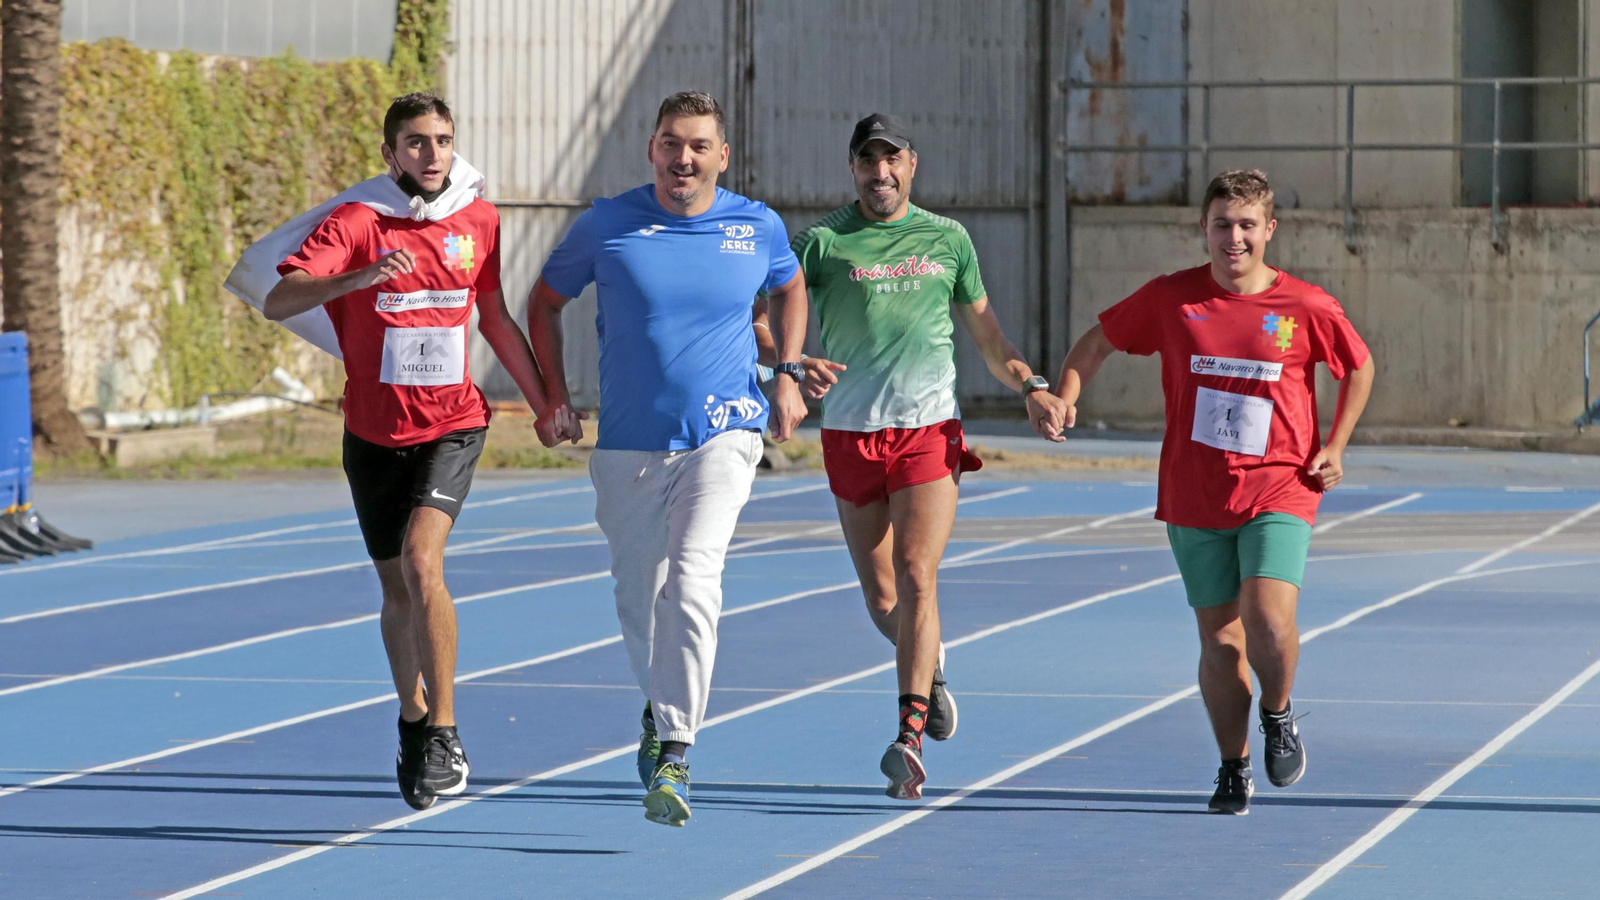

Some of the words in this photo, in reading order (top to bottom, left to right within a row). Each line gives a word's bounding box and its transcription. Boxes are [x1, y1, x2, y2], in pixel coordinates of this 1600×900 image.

[720, 240, 756, 251] JEREZ
[849, 255, 945, 281] maratón
[876, 280, 921, 294] JEREZ
[405, 296, 440, 306] Navarro
[440, 294, 467, 303] Hnos.
[419, 342, 425, 357] 1
[401, 364, 445, 373] MIGUEL
[1217, 362, 1255, 374] Navarro
[1256, 364, 1280, 376] Hnos.
[1225, 408, 1232, 421] 1
[1216, 427, 1240, 439] JAVI
